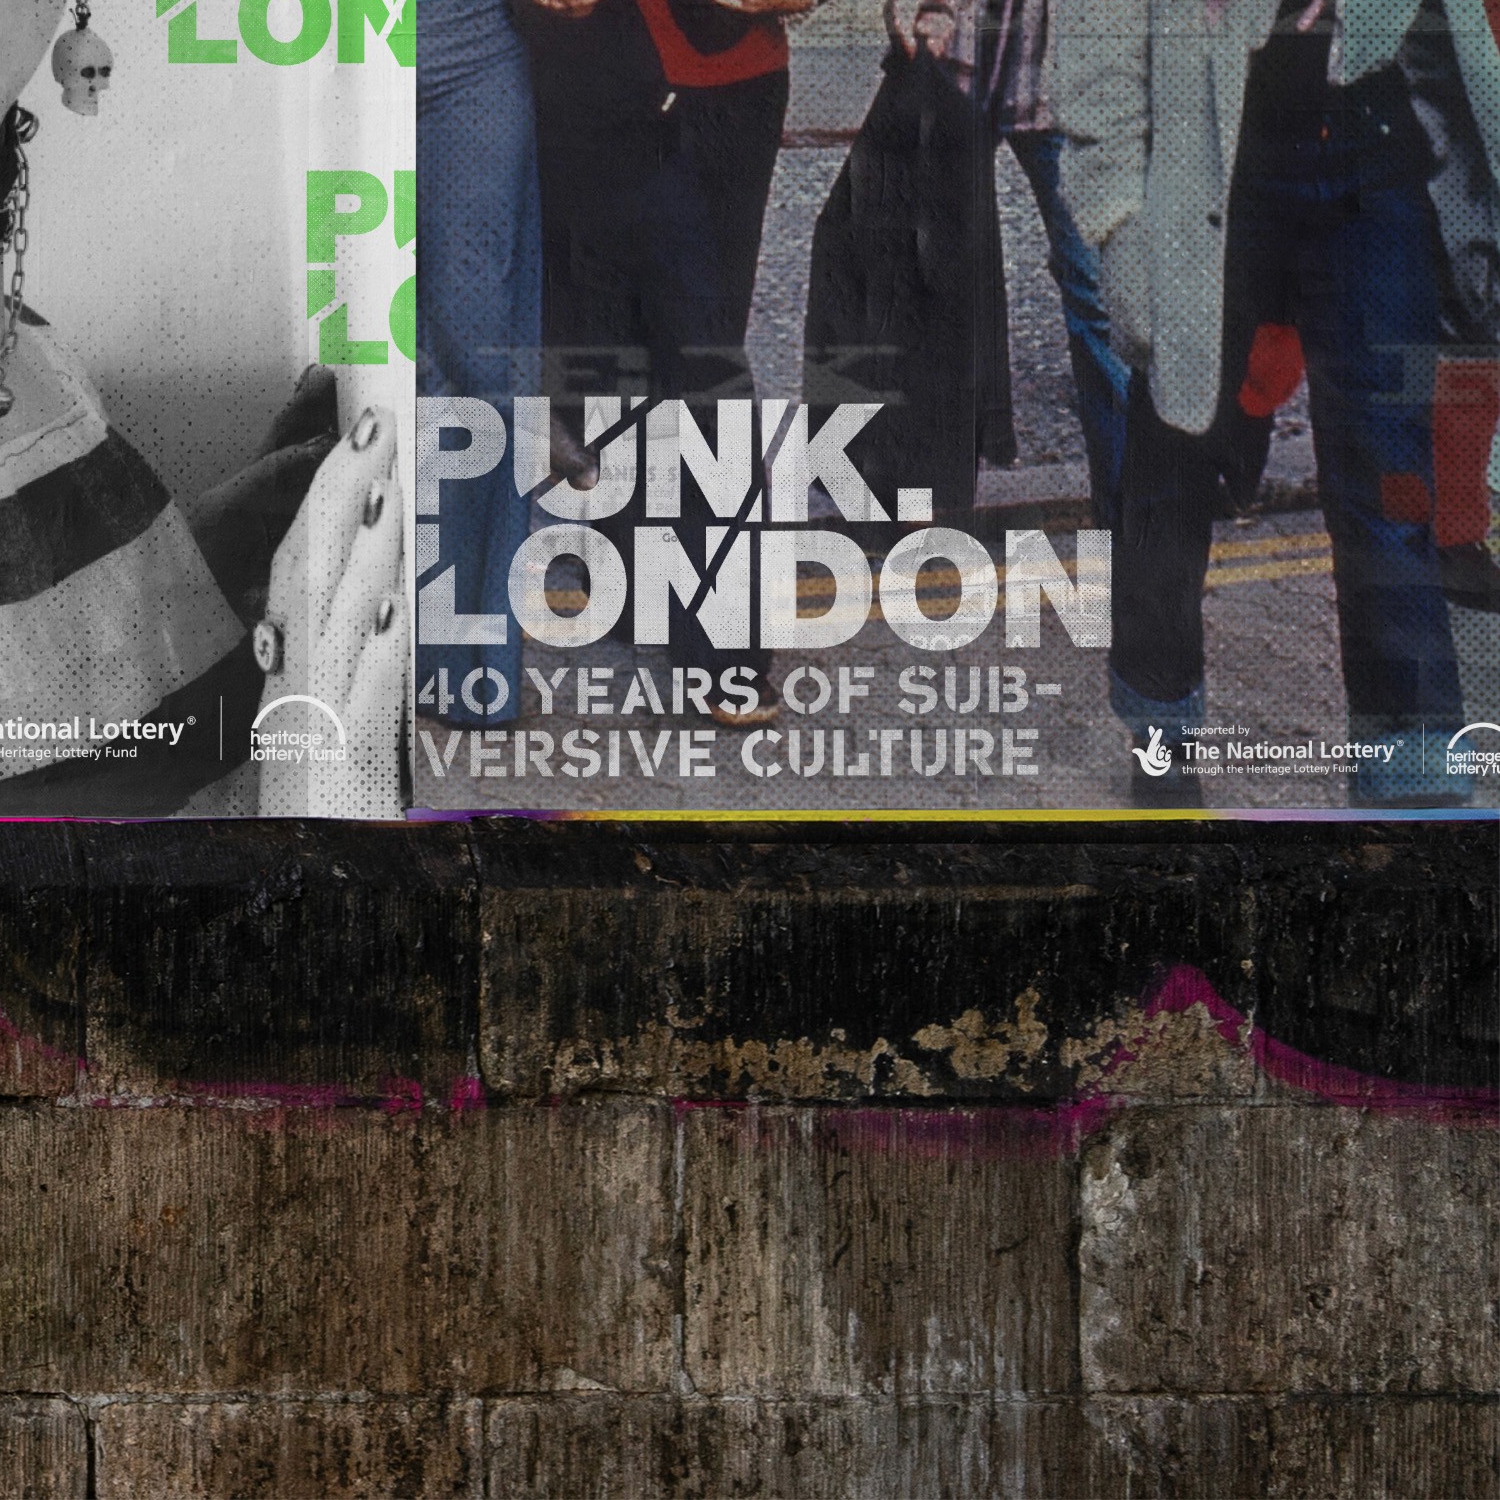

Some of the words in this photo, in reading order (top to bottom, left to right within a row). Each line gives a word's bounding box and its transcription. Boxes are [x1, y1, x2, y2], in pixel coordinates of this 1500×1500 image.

[416, 396, 933, 522] PUNK.
[416, 524, 1112, 650] LONDON
[418, 666, 510, 716] 40
[527, 666, 759, 716] YEARS
[783, 666, 875, 716] OF
[898, 666, 1062, 716] SUB-
[250, 730, 323, 749] heritage
[1181, 725, 1235, 737] Supported
[1238, 725, 1250, 737] by
[55, 745, 102, 761] Lottery
[105, 745, 138, 759] Fund
[250, 746, 305, 764] lottery
[307, 745, 347, 761] fund
[418, 728, 717, 778] VERSIVE
[741, 728, 1040, 778] CULTURE
[1182, 742, 1220, 760] The
[1227, 740, 1314, 760] National
[1182, 764, 1224, 776] through
[1226, 764, 1244, 775] the
[1247, 763, 1292, 776] Heritage
[1294, 763, 1331, 775] Lottery
[1333, 763, 1358, 774] Fund
[1446, 763, 1489, 777] lottery
